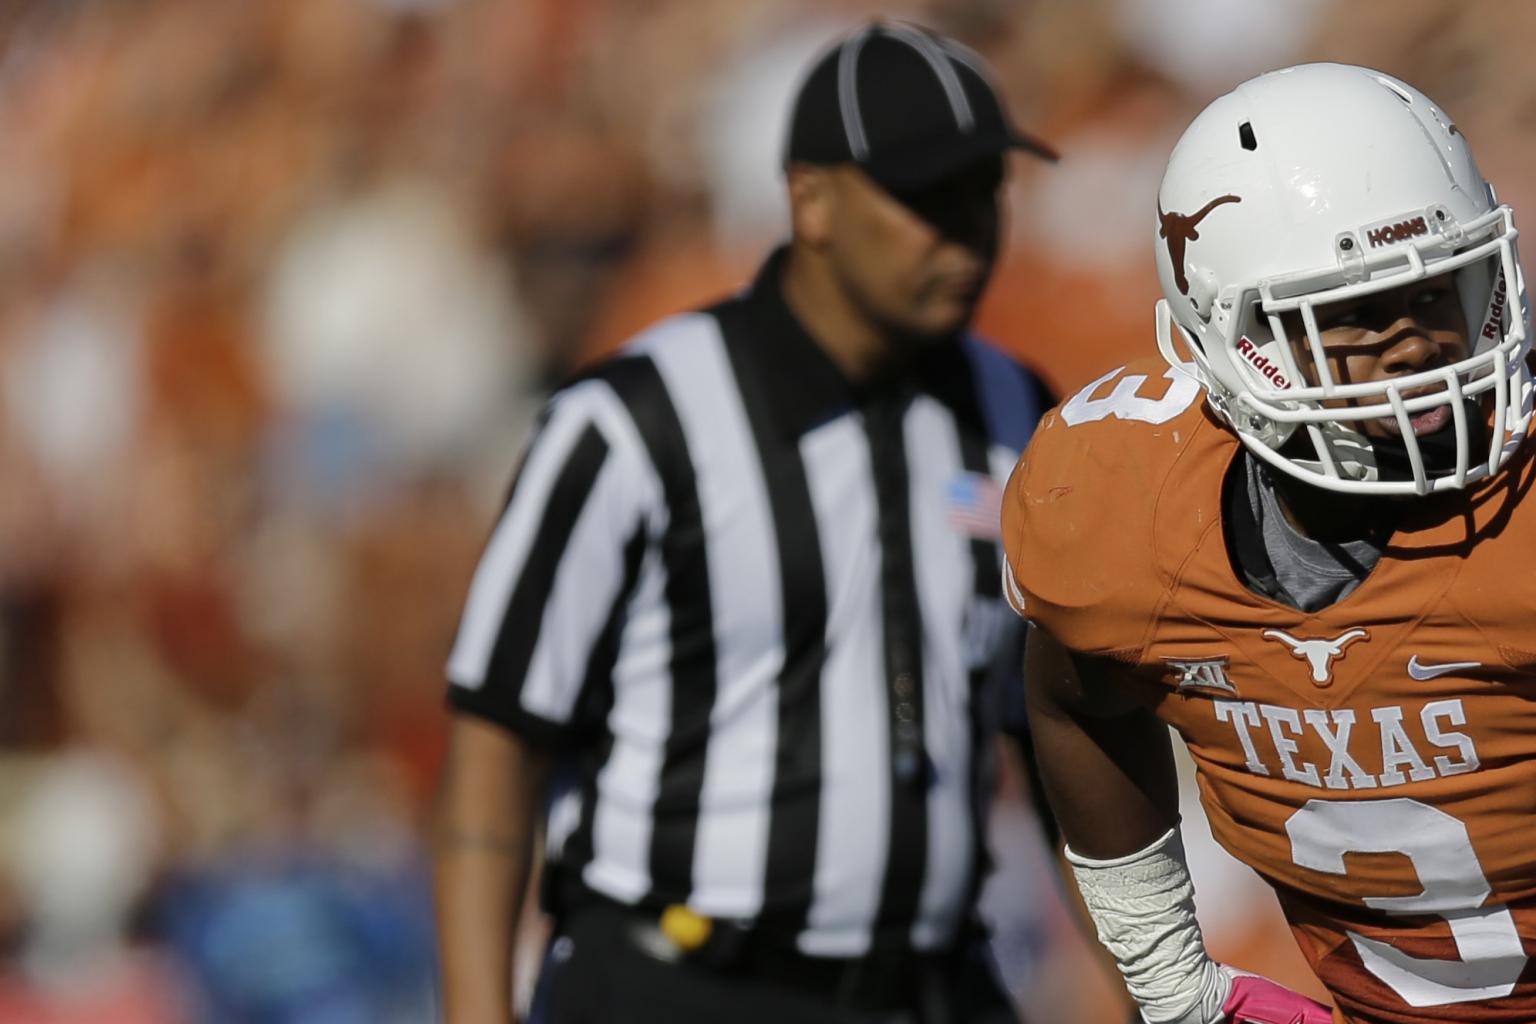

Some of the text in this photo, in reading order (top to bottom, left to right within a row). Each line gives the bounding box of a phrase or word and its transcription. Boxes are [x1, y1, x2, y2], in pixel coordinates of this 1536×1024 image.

[1366, 216, 1428, 248] HORNS
[1060, 361, 1201, 428] 3
[1213, 698, 1481, 790] TEXAS
[1284, 797, 1529, 1008] 3
